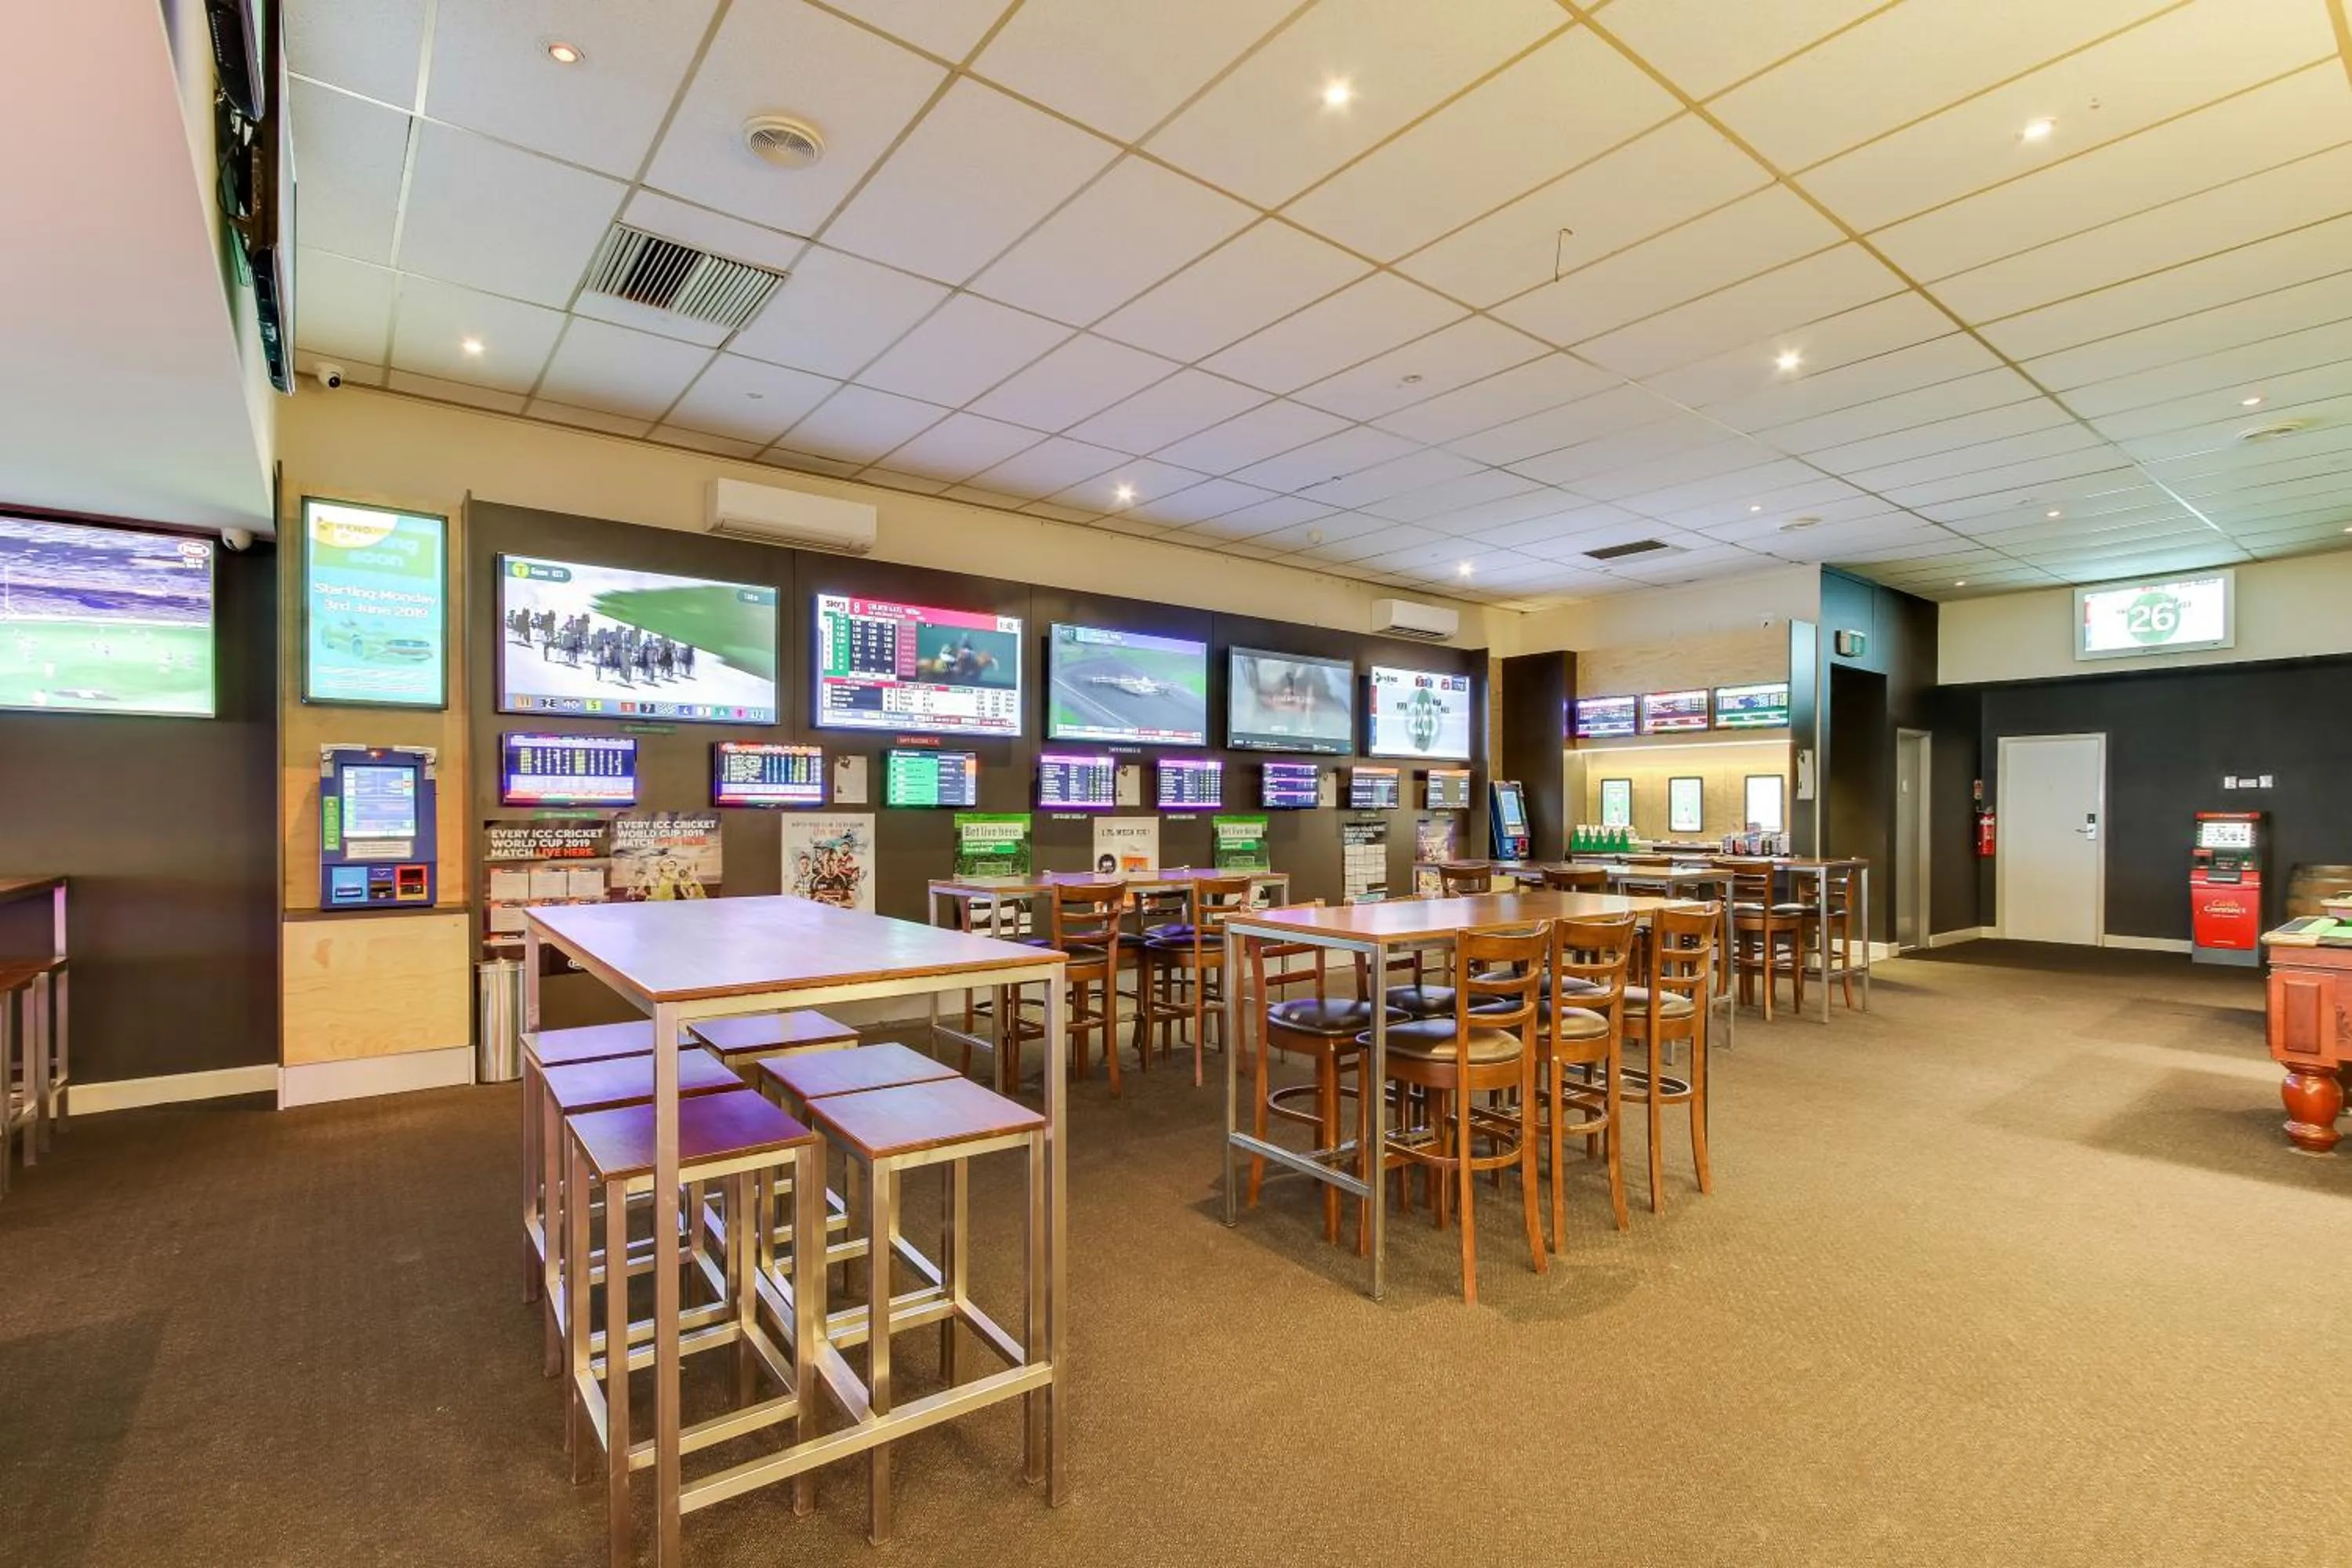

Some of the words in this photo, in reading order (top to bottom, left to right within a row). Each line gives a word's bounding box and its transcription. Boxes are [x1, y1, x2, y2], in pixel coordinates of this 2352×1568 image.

[315, 582, 376, 600] Starting
[379, 590, 437, 607] Monday
[324, 599, 350, 612] 3rd
[355, 603, 391, 615] June
[2129, 601, 2176, 633] 26
[673, 820, 715, 829] CRICKET
[491, 829, 529, 838] EVERY
[532, 829, 554, 838] ICC
[555, 829, 604, 838] CRICKET
[965, 826, 979, 837] Bet
[981, 826, 996, 837] live
[491, 839, 535, 848] WORLD
[539, 839, 562, 848] CUP
[565, 839, 590, 848] 2019
[616, 838, 654, 847] MATCH
[491, 848, 534, 857] MATCH
[535, 848, 561, 857] LIVE
